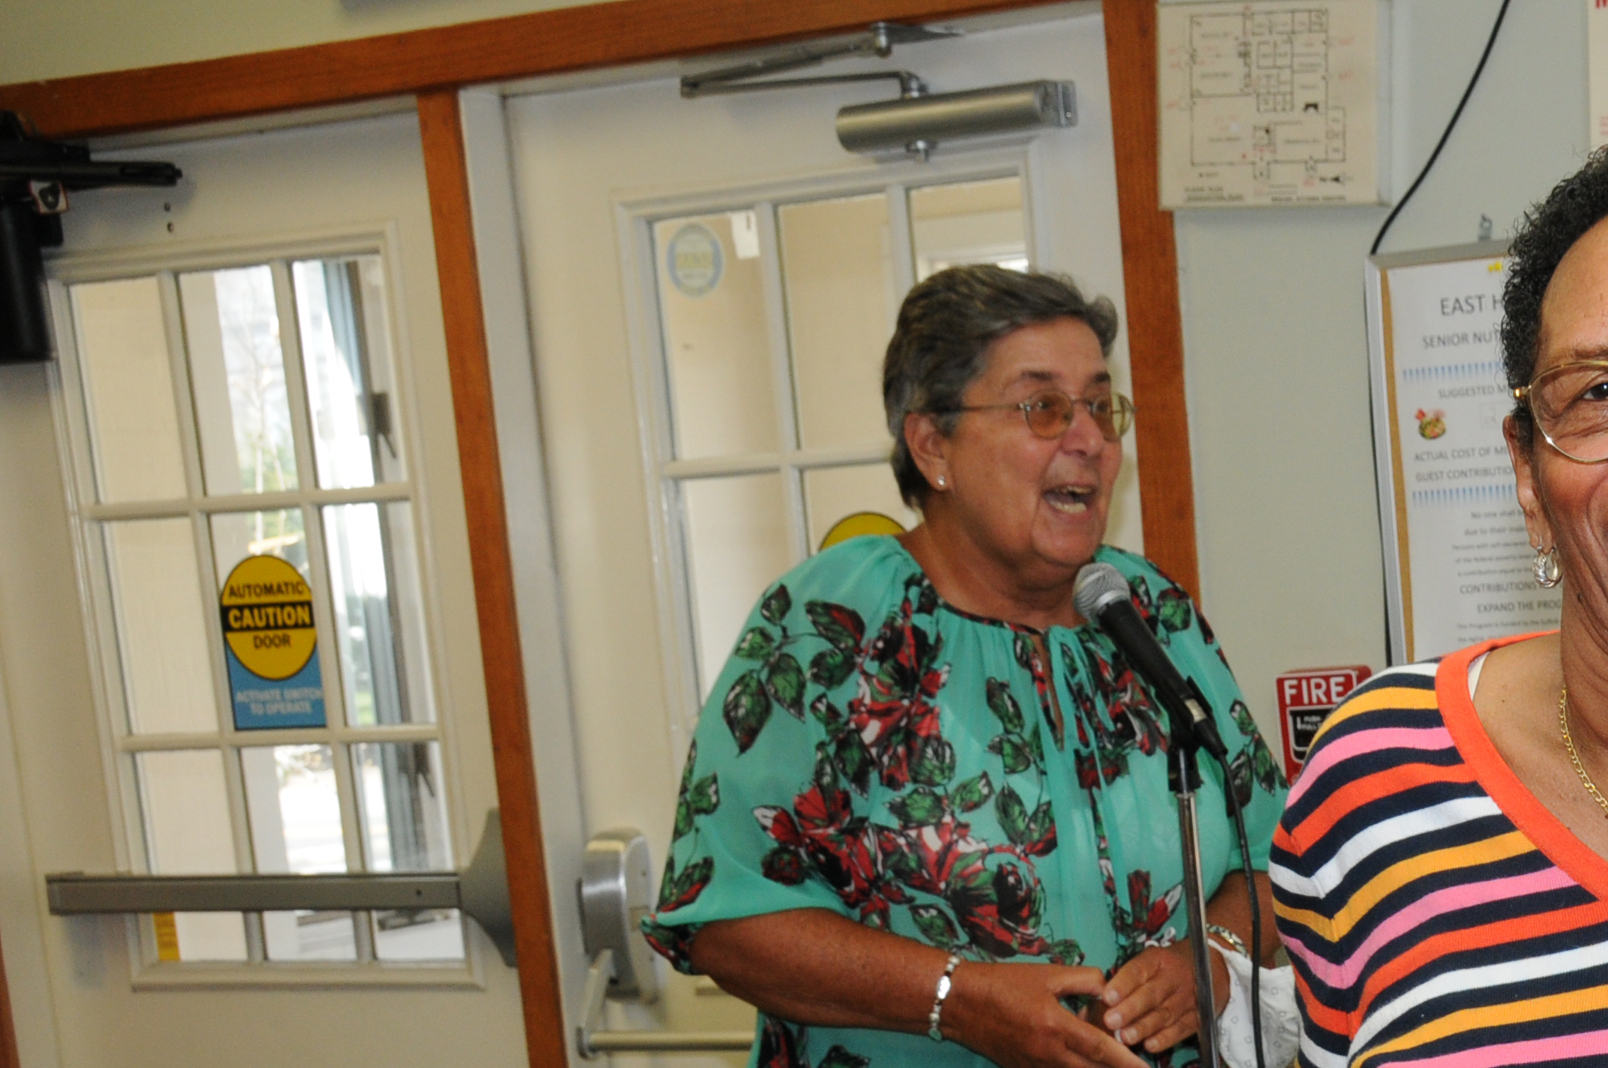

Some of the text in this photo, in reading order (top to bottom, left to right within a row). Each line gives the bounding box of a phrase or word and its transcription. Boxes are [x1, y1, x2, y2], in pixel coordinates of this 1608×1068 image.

[1440, 295, 1486, 317] EAST
[1422, 334, 1469, 349] SENIOR
[1438, 384, 1494, 399] SUGGESTED
[1414, 451, 1449, 463] ACTUAL
[1451, 449, 1476, 460] COST
[1479, 448, 1491, 459] OF
[1415, 471, 1444, 483] GUEST
[228, 581, 304, 598] AUTOMATIC
[1460, 582, 1537, 595] CONTRIBUTIONS
[1477, 603, 1515, 614] EXPAND
[1518, 601, 1535, 611] THE
[228, 605, 311, 629] CAUTION
[253, 634, 291, 649] DOOR
[236, 688, 282, 703] ACTIVATE
[1284, 677, 1345, 705] FIRE
[250, 701, 312, 716] TO OPERATE
